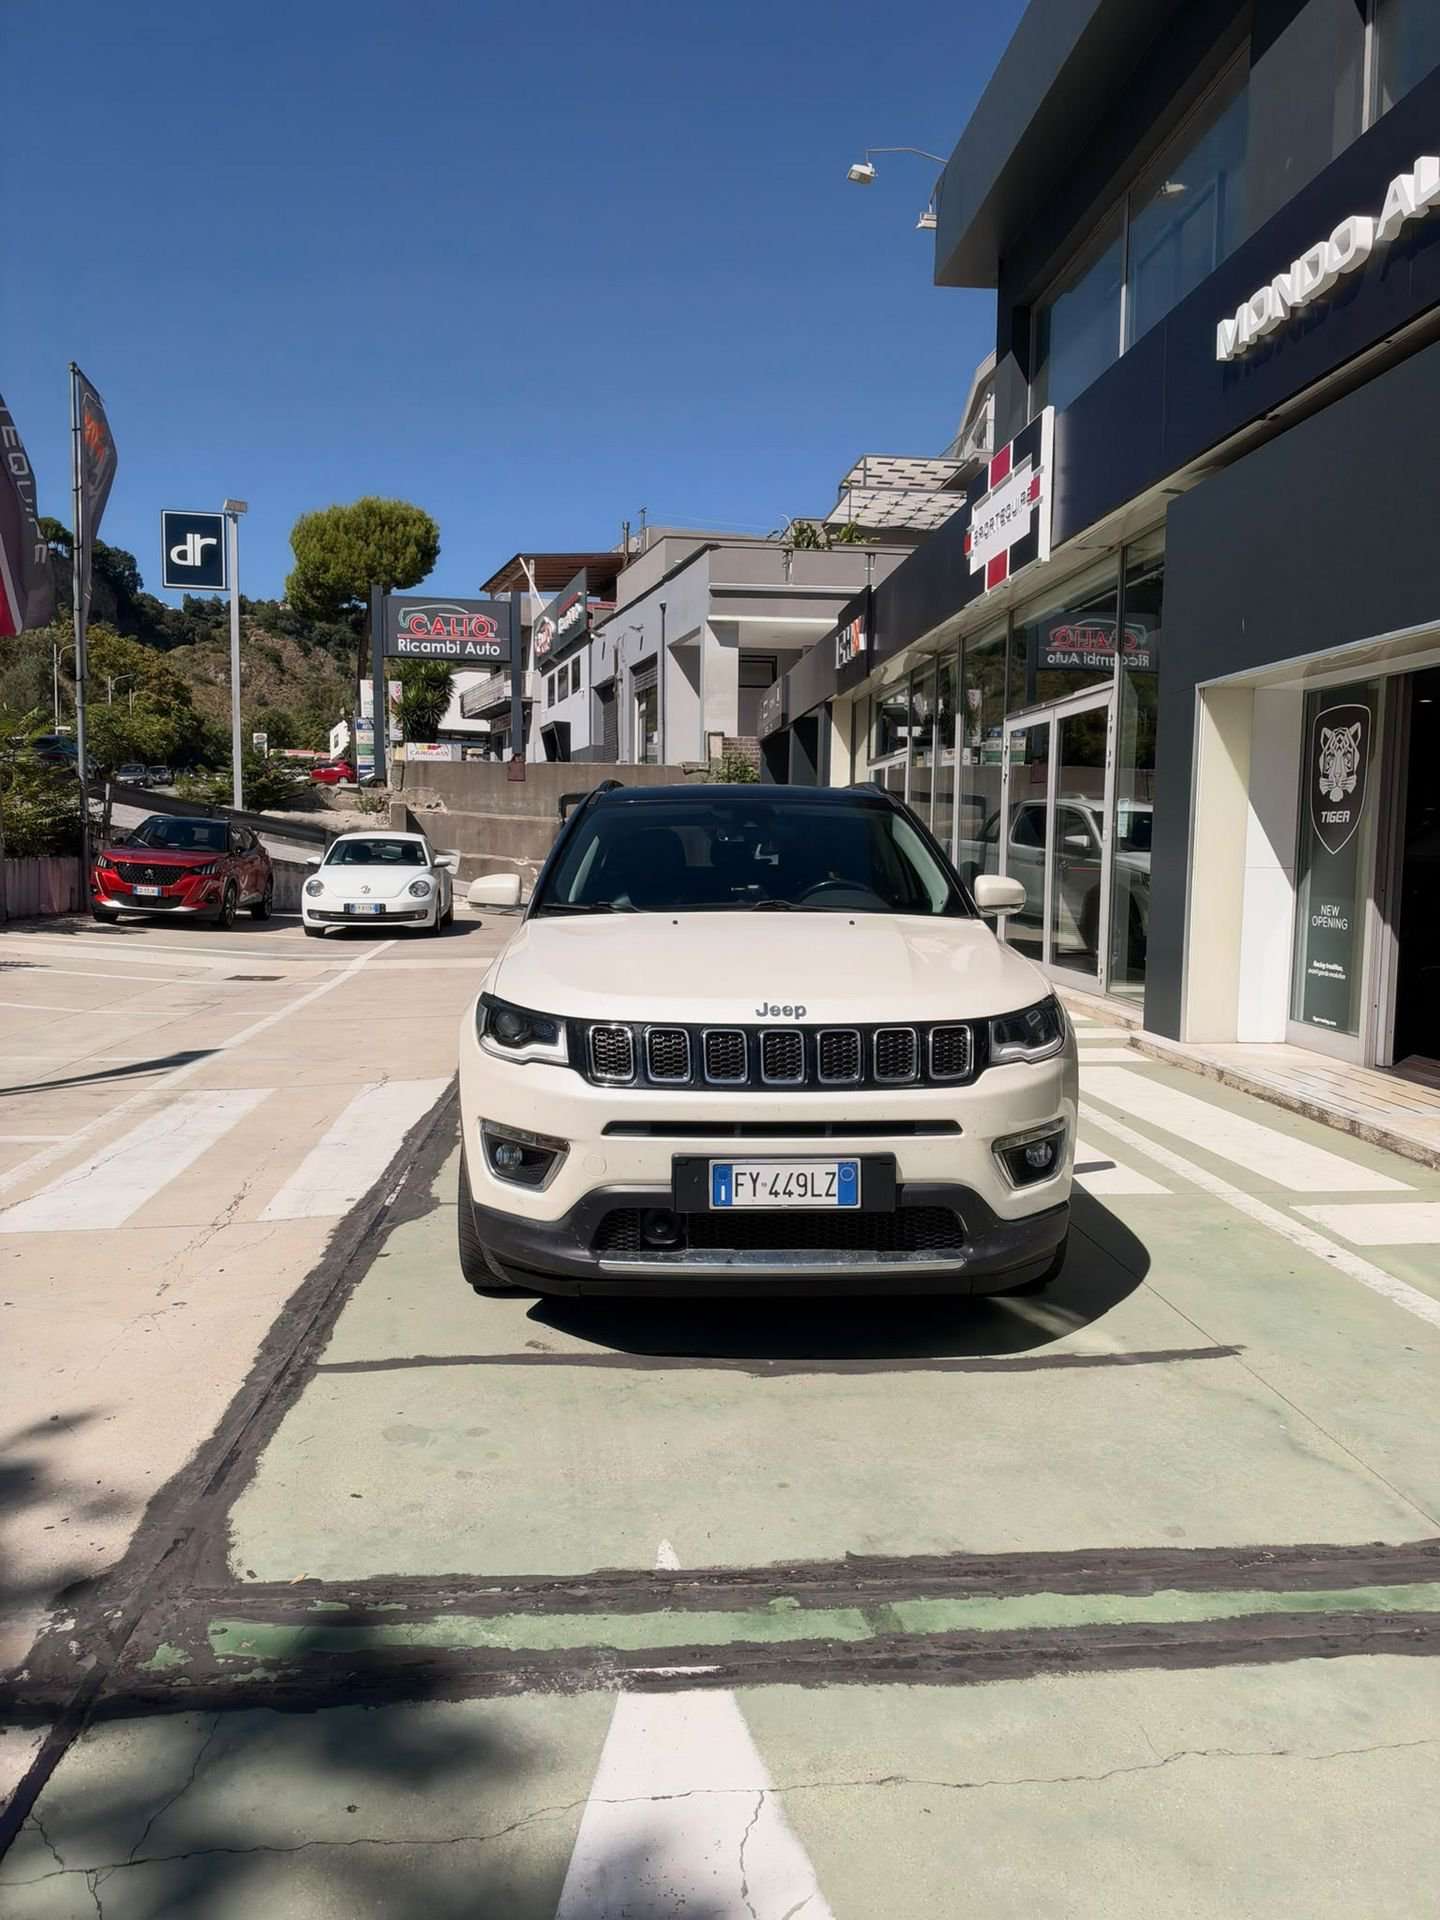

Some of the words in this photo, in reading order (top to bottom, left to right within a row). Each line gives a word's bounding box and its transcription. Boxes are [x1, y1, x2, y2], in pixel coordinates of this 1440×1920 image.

[1216, 215, 1375, 361] MONDO
[170, 533, 217, 567] dr
[397, 639, 460, 654] Ricambi
[465, 641, 500, 656] Auto
[1321, 810, 1351, 823] TIGER
[1320, 904, 1341, 917] NEW
[1311, 915, 1348, 931] OPENING
[755, 1002, 807, 1020] Jeep
